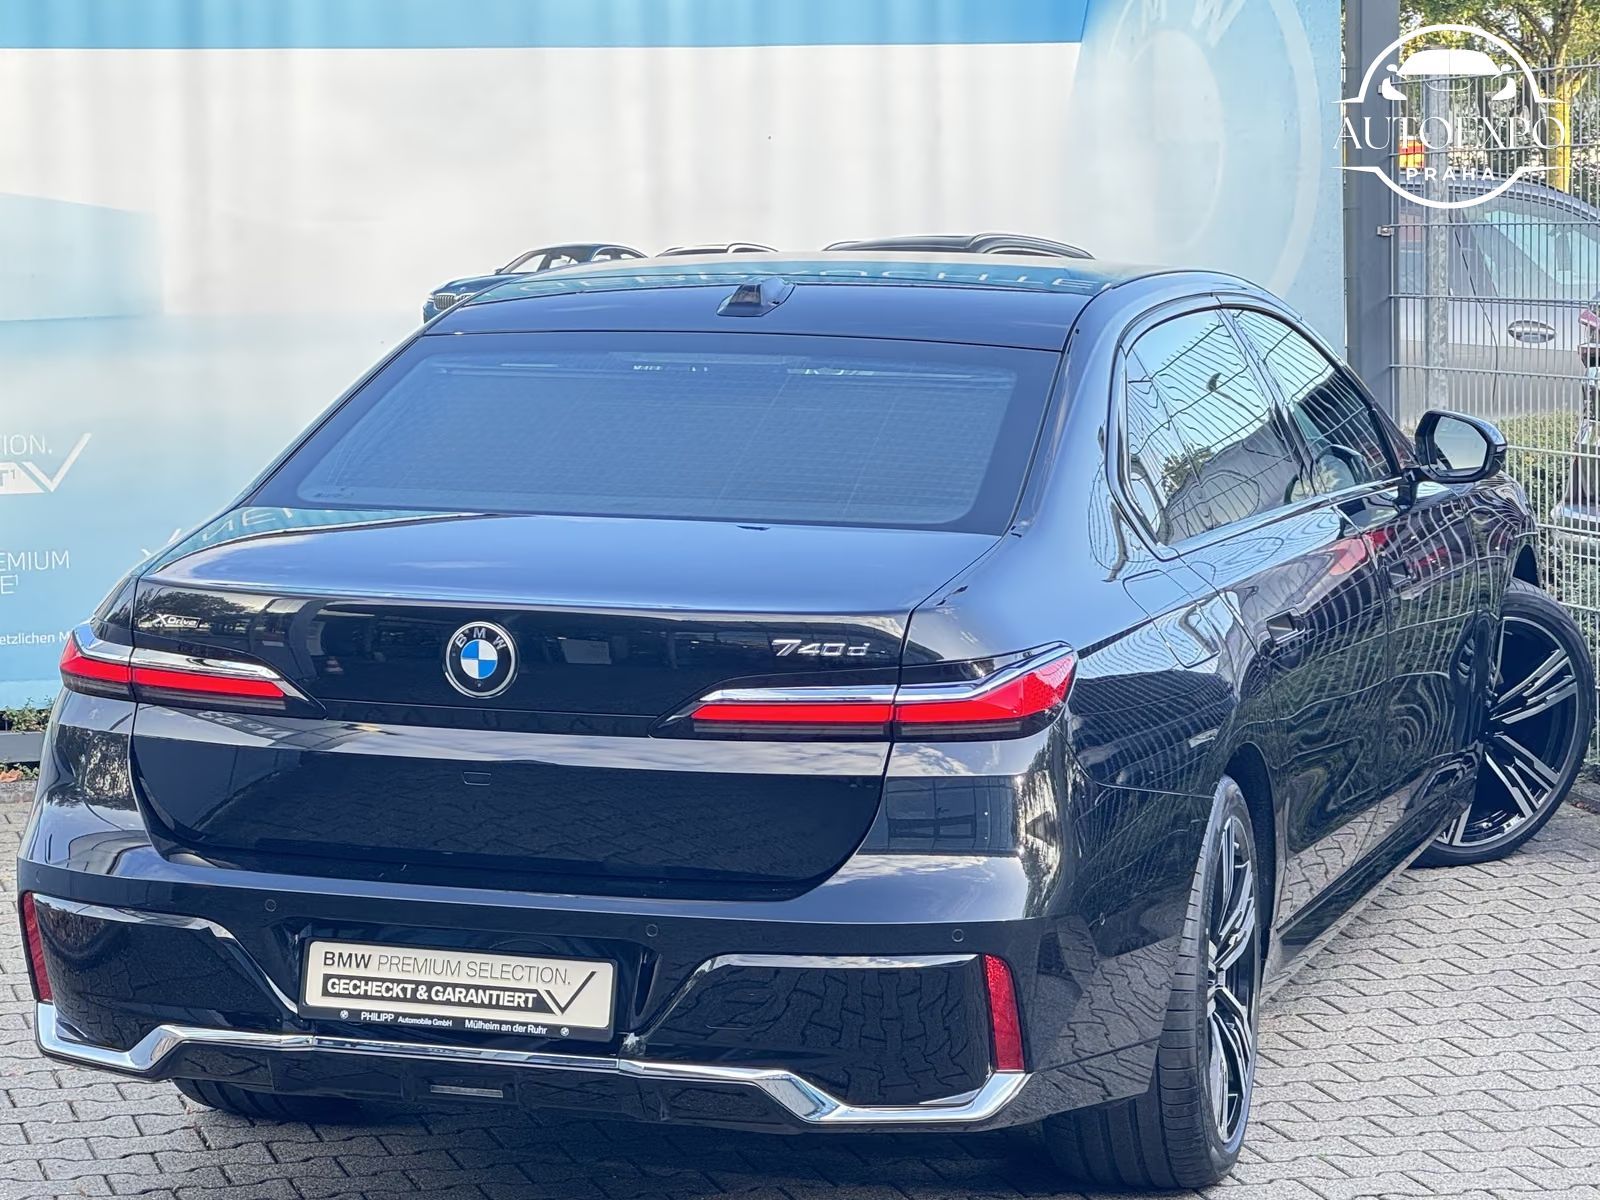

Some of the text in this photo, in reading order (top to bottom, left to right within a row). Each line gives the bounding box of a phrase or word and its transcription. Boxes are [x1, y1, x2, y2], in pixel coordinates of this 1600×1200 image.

[455, 627, 507, 650] BMW
[323, 951, 572, 985] BMW PREMIUM SELECTION.
[327, 978, 538, 1008] GECHECKT & GARANTIERT
[361, 1011, 548, 1035] PHILIPP Automobile GmbH Mülheim an der Ruhr
